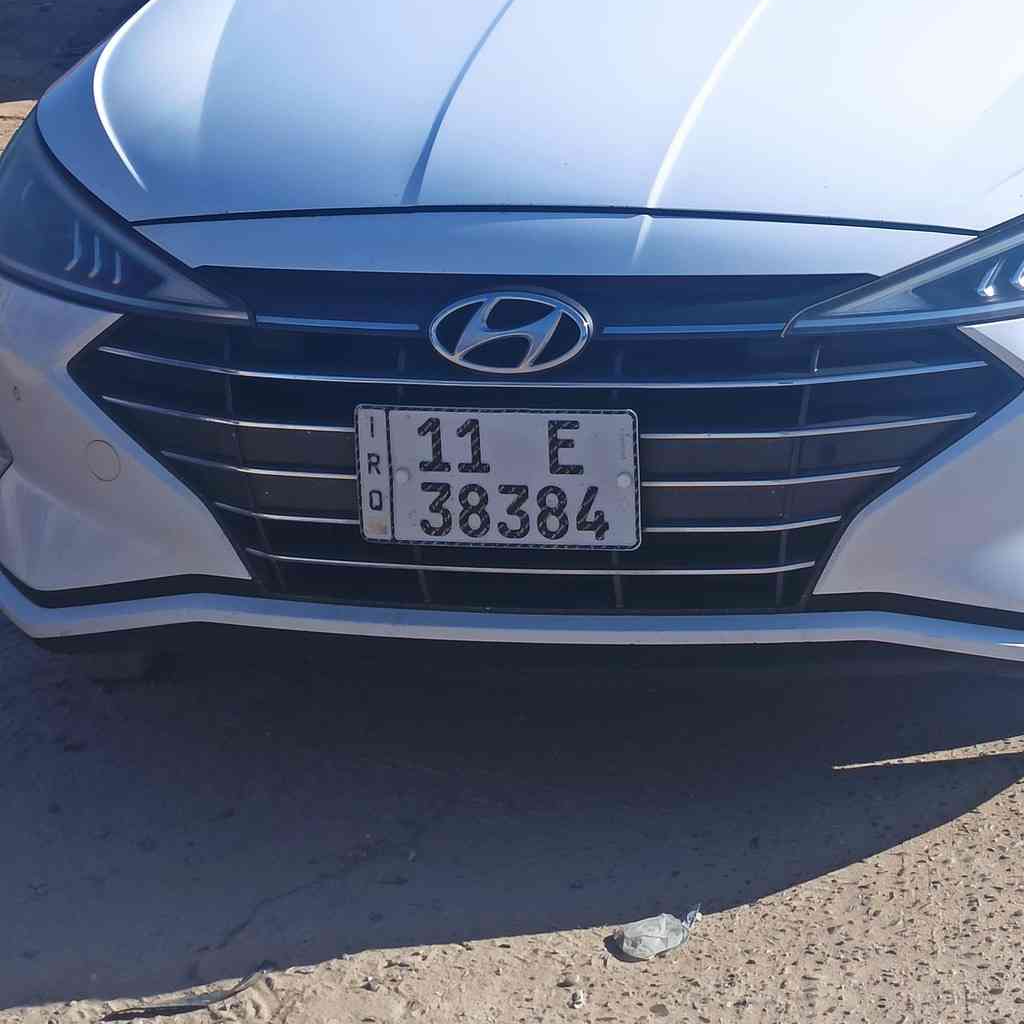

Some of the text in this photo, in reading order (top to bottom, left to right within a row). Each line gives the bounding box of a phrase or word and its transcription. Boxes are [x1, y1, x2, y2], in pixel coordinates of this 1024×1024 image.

[417, 417, 584, 475] 11 E
[419, 481, 610, 541] 38384
